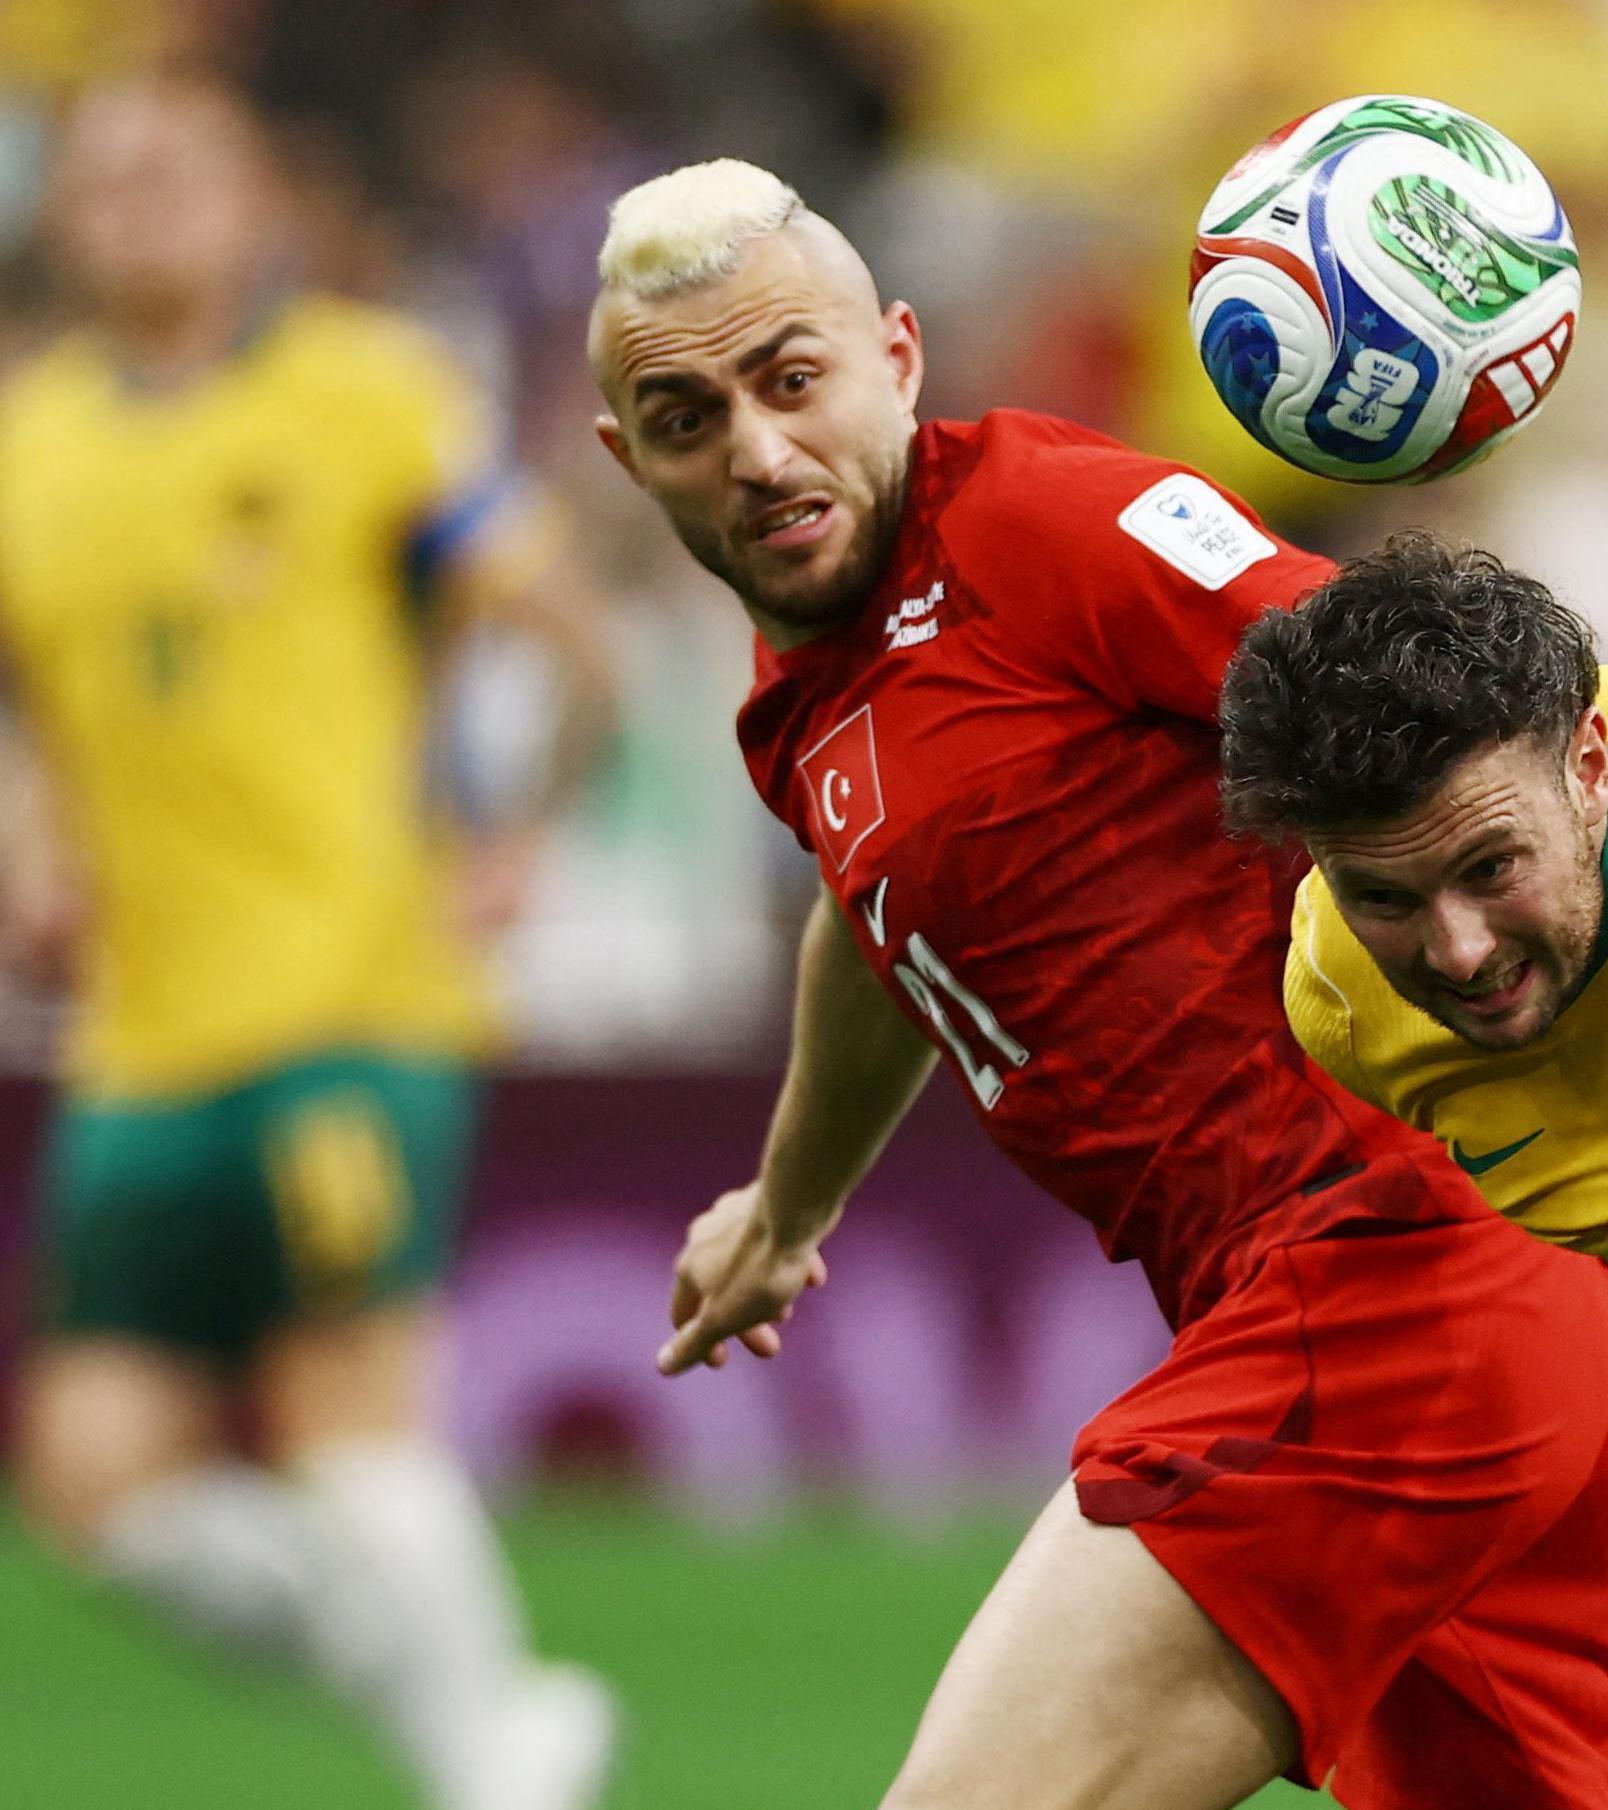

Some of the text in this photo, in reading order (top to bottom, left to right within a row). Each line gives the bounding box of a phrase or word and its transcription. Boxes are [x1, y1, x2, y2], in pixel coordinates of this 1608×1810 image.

[1387, 215, 1482, 308] TRIONDA
[1372, 359, 1402, 378] FIFA
[893, 931, 1031, 1111] 21
